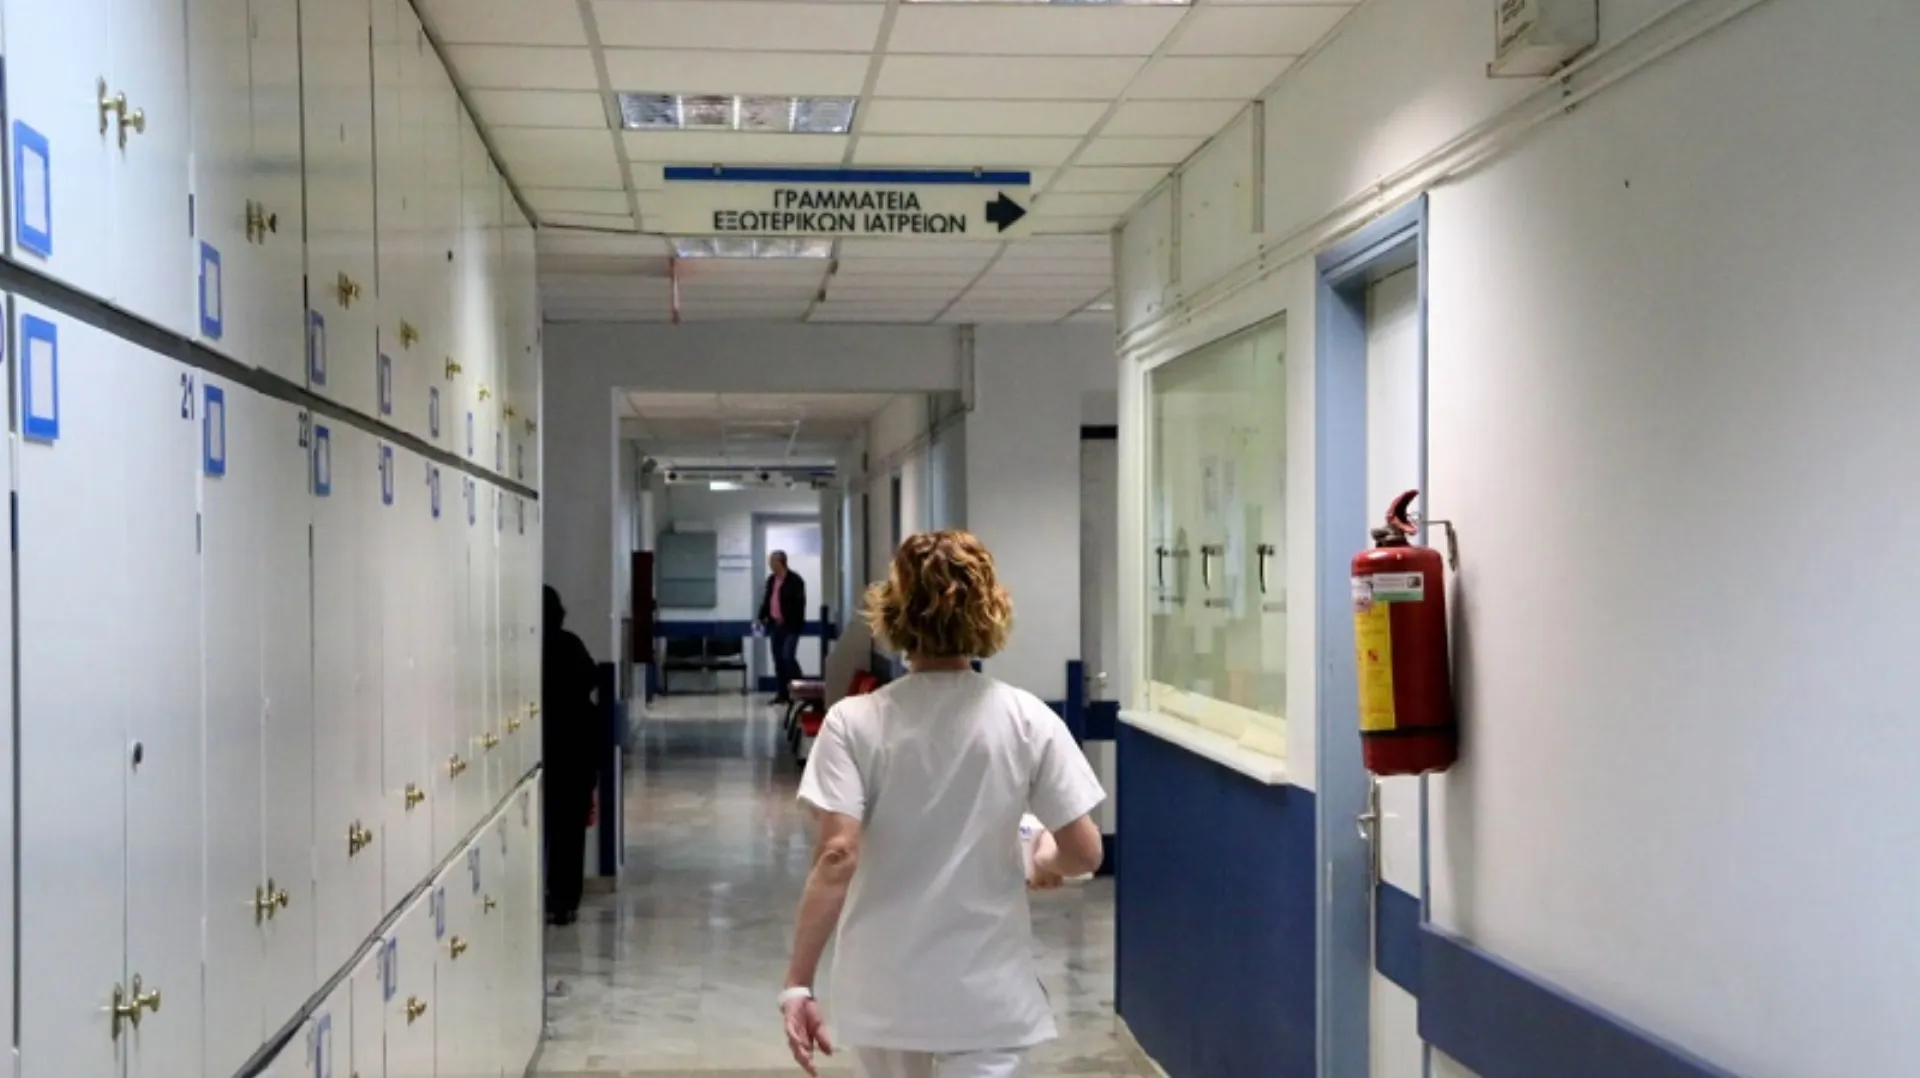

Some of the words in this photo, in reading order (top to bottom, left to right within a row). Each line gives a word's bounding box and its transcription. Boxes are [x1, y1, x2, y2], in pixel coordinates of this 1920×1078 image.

[774, 190, 920, 211] ΓΡΑΜΜΑΤΕΙΑ
[713, 211, 856, 231] ΕΞΩΤΕΡΙΚΩΝ
[863, 212, 967, 233] ΙΑΤΡΕΙΩΝ
[180, 372, 194, 420] 21
